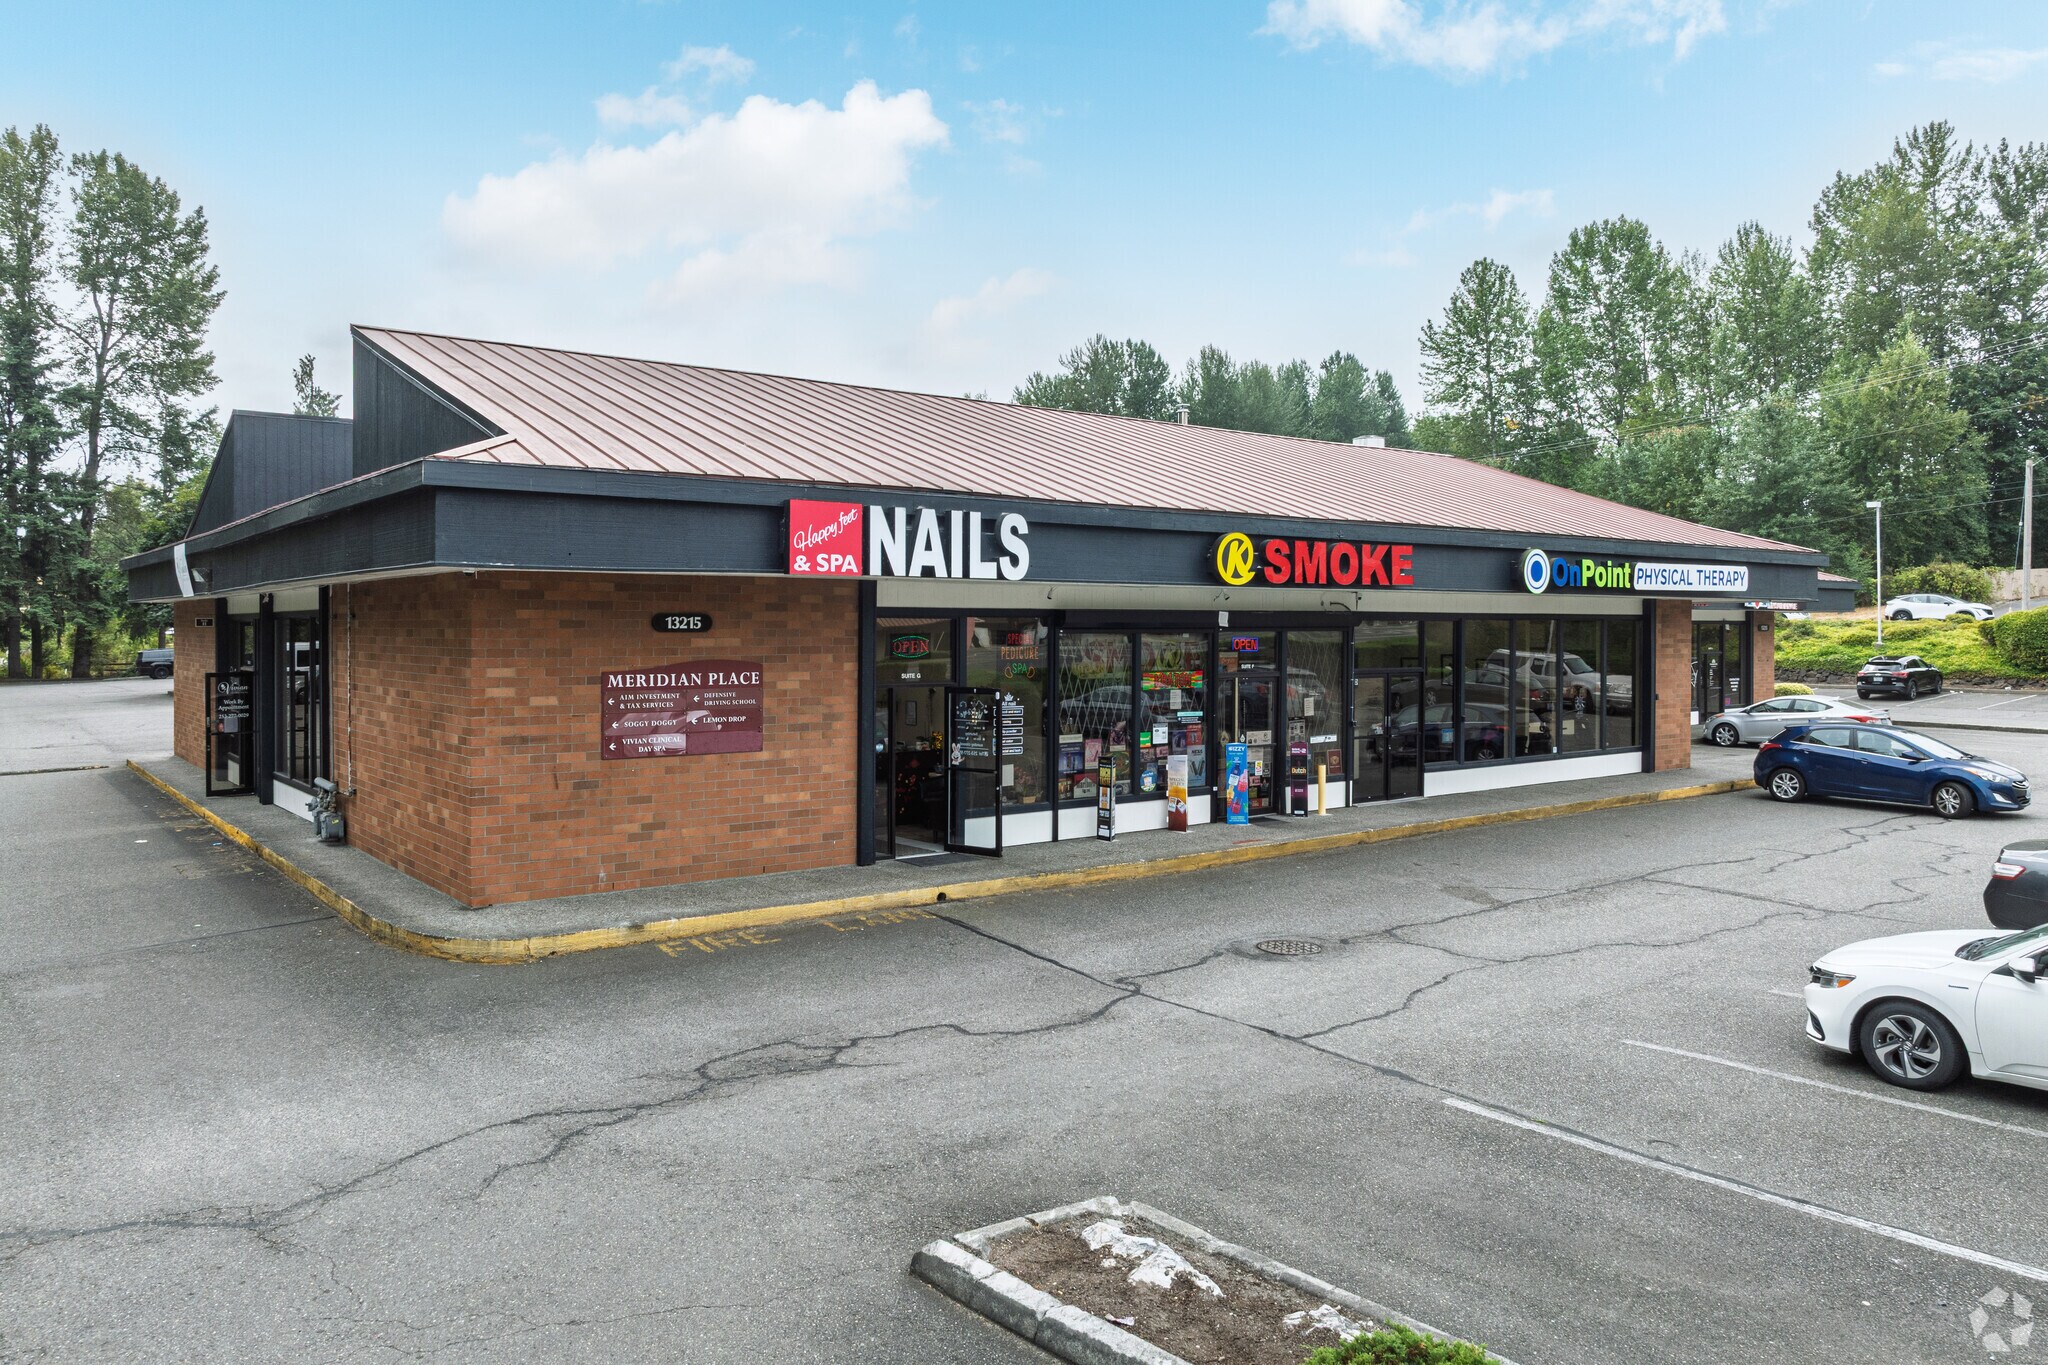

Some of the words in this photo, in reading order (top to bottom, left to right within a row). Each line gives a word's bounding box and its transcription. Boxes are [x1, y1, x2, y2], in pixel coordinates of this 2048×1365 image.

[793, 524, 839, 551] Happy
[838, 508, 859, 534] feet
[869, 505, 1030, 581] NAILS
[793, 555, 811, 572] &
[816, 553, 858, 573] SPA
[1263, 538, 1414, 586] SMOKE
[1552, 557, 1631, 588] OnPoint
[1636, 567, 1693, 586] PHYSICAL
[1696, 569, 1746, 587] THERAPY
[665, 616, 702, 629] 13215
[893, 640, 929, 653] OPEN
[1233, 639, 1257, 650] OPEN
[1001, 646, 1039, 660] PEDICURE
[1012, 663, 1028, 674] SPA
[607, 672, 702, 688] MERIDIAN
[708, 671, 760, 686] PLACE
[636, 692, 680, 700] INVESTMENT
[642, 701, 674, 709] SERVICES
[651, 719, 677, 727] DOGGY
[648, 736, 681, 744] CLINICAL
